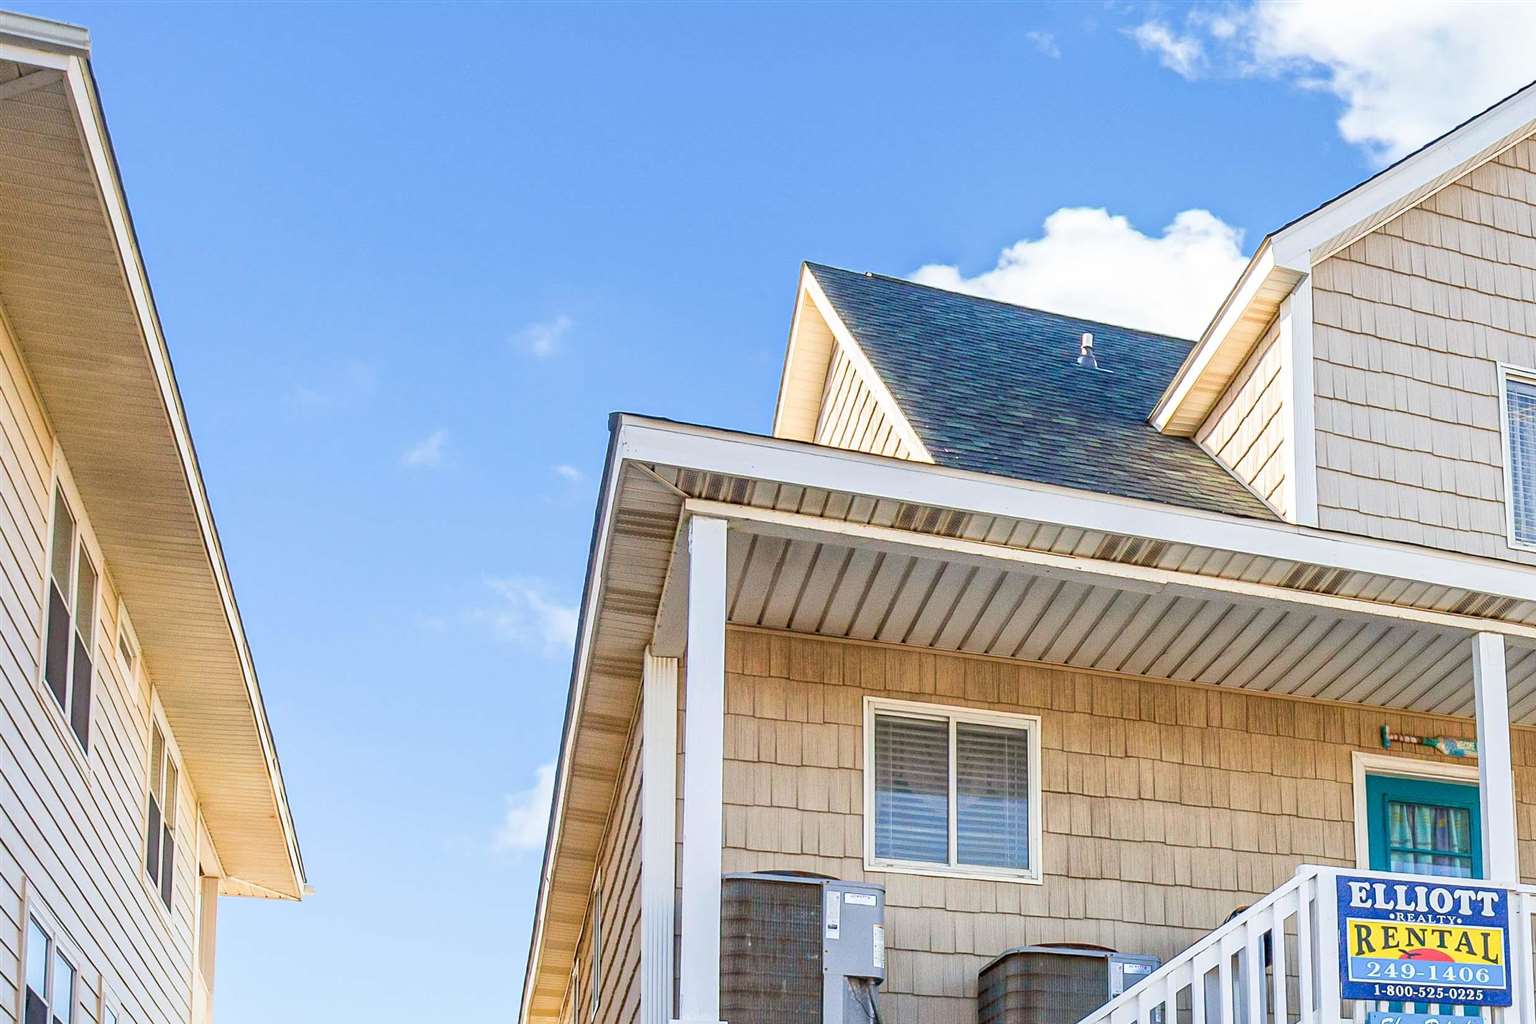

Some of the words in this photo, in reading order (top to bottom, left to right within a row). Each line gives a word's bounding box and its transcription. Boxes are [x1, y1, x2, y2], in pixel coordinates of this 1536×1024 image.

[1347, 881, 1499, 917] ELLIOTT
[1354, 924, 1499, 964] RENTAL
[1366, 961, 1490, 983] 249-1406
[1373, 984, 1484, 1001] 1-800-525-0225
